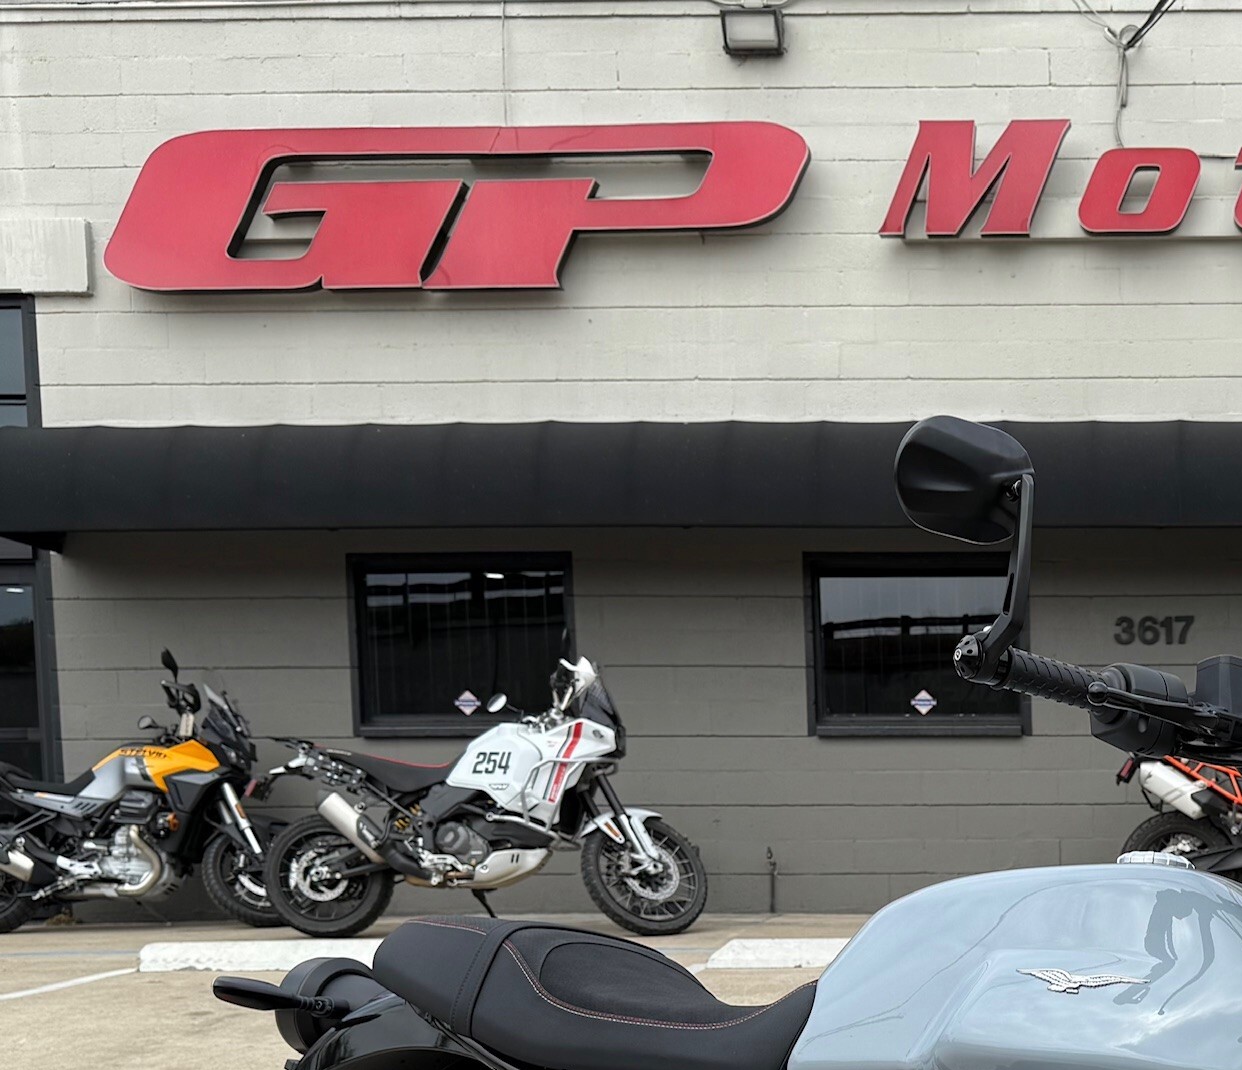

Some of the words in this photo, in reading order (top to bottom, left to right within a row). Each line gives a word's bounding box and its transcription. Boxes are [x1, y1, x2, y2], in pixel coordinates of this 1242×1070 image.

[103, 121, 811, 291] GP
[1113, 615, 1195, 645] 3617
[471, 751, 512, 775] 254
